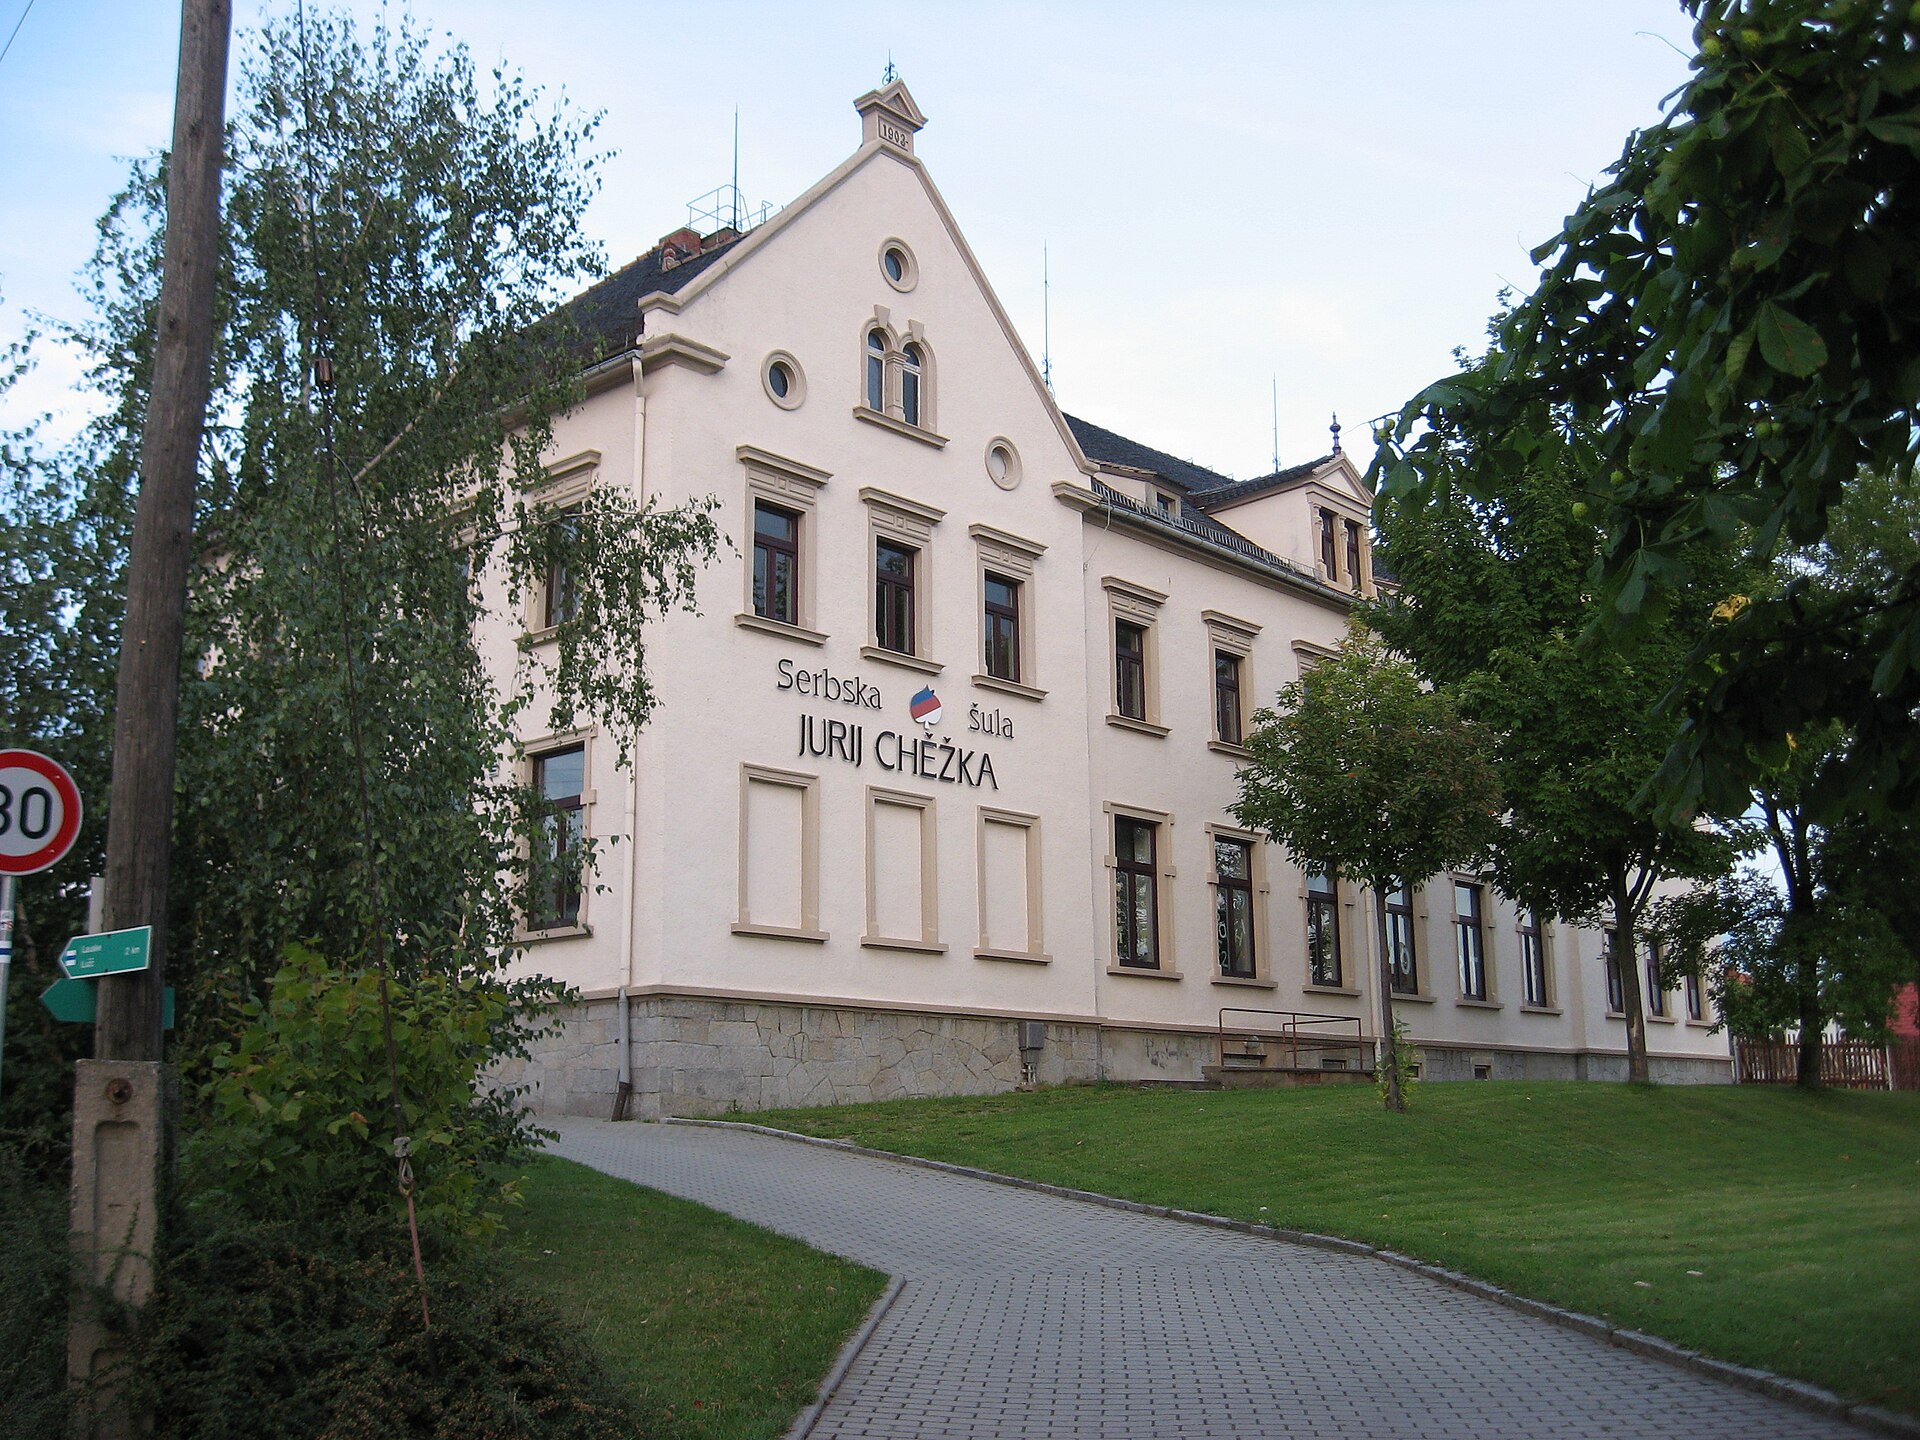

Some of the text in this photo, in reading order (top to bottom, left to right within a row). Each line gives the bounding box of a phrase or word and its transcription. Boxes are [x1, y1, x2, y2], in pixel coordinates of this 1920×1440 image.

[776, 658, 1015, 739] Serbska šula
[799, 713, 999, 790] JURIJ CHĚŽKA
